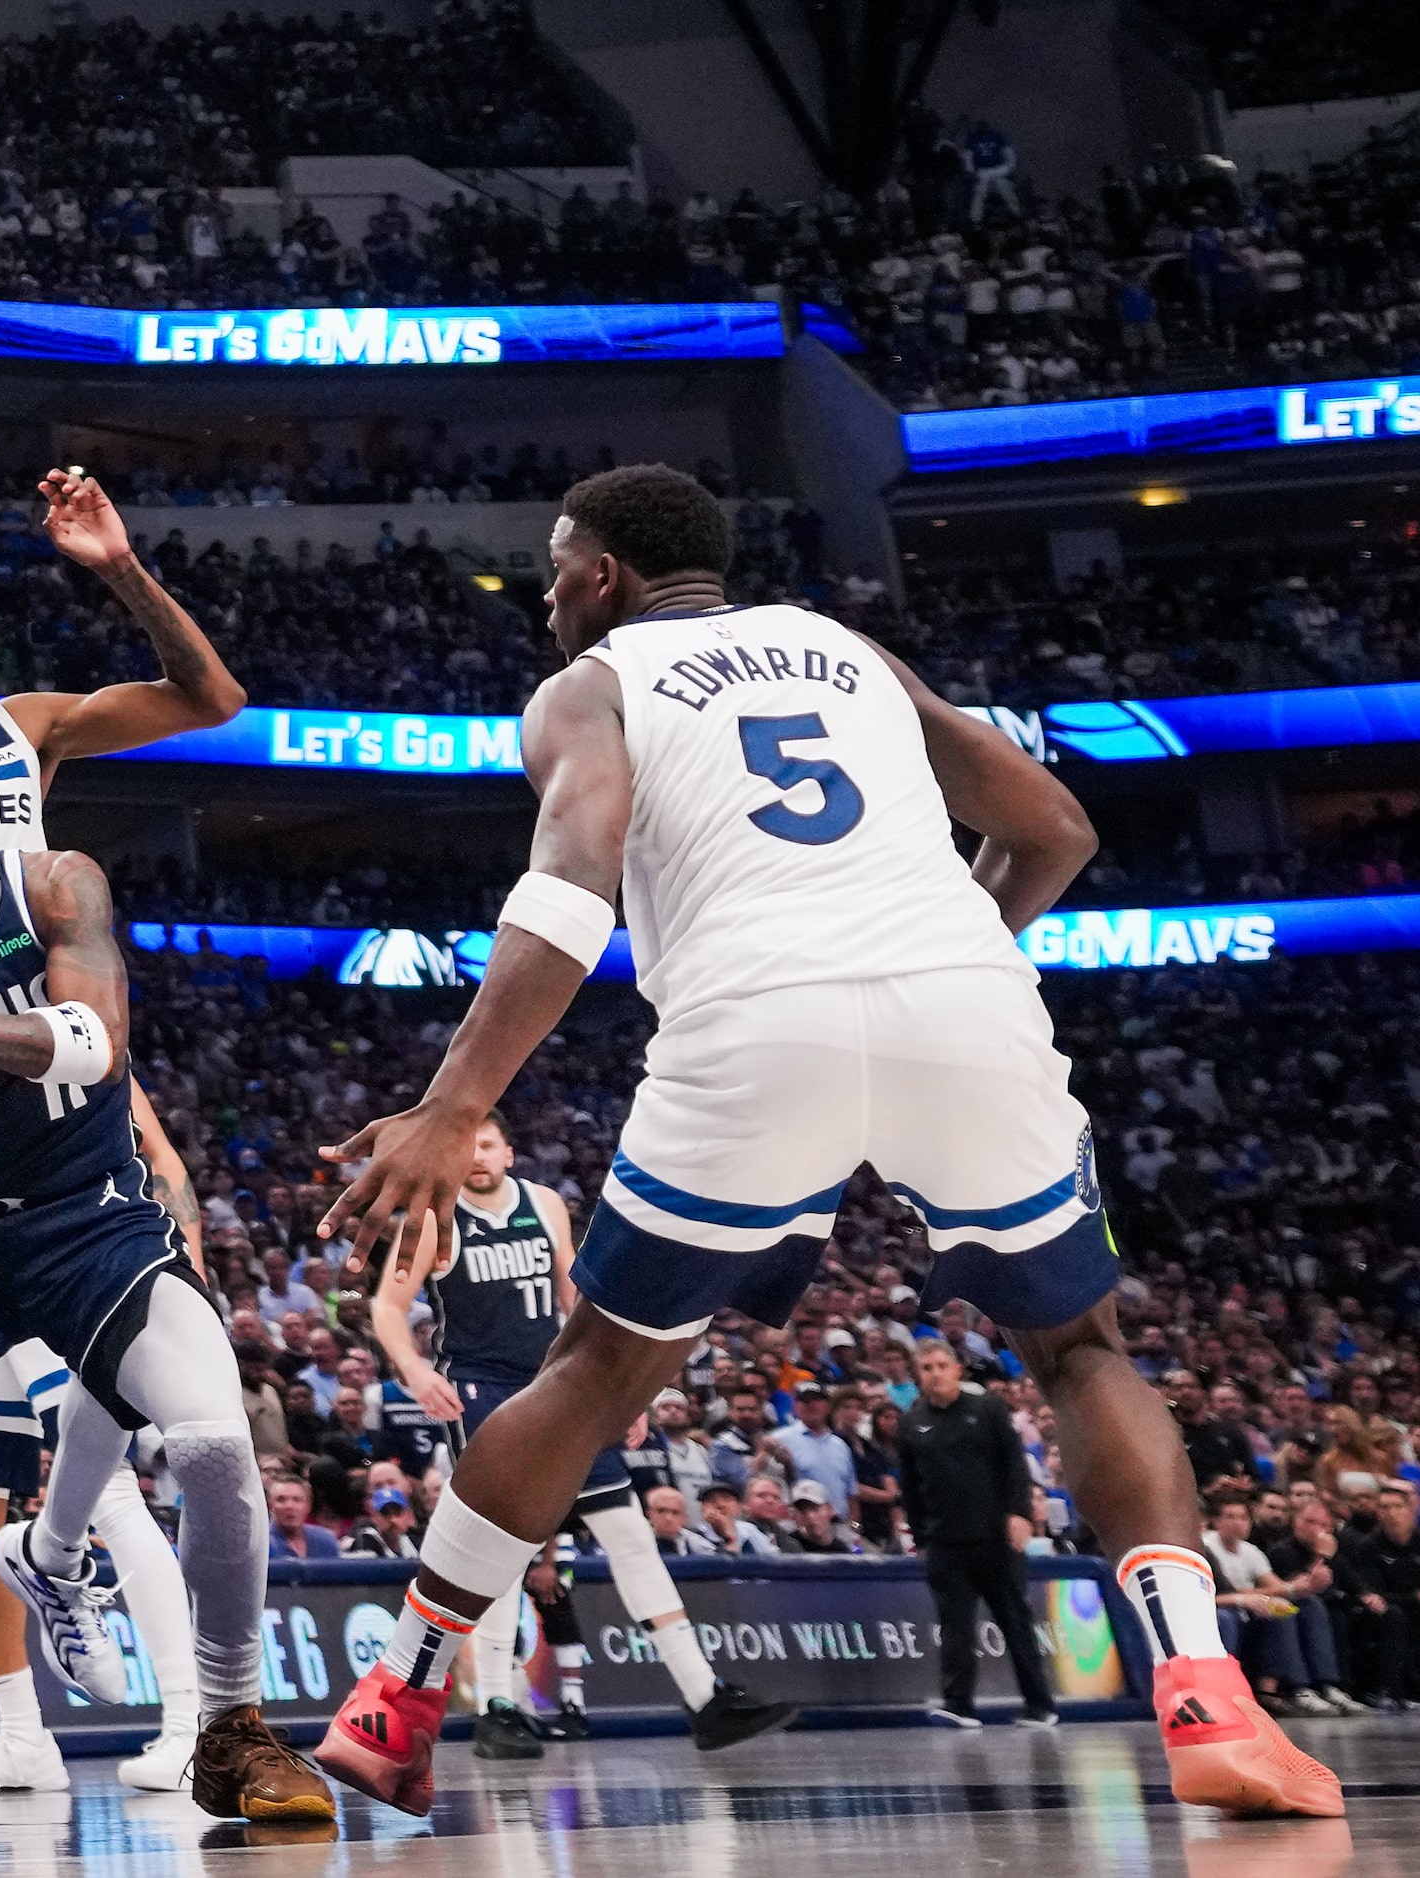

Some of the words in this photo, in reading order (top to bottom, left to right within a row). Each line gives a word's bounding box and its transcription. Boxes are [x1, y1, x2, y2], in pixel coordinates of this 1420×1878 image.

[652, 645, 860, 712] EDWARDS
[737, 711, 865, 846] 5
[513, 1275, 552, 1320] 77
[790, 1621, 877, 1661] WILL
[877, 1619, 924, 1660] BE
